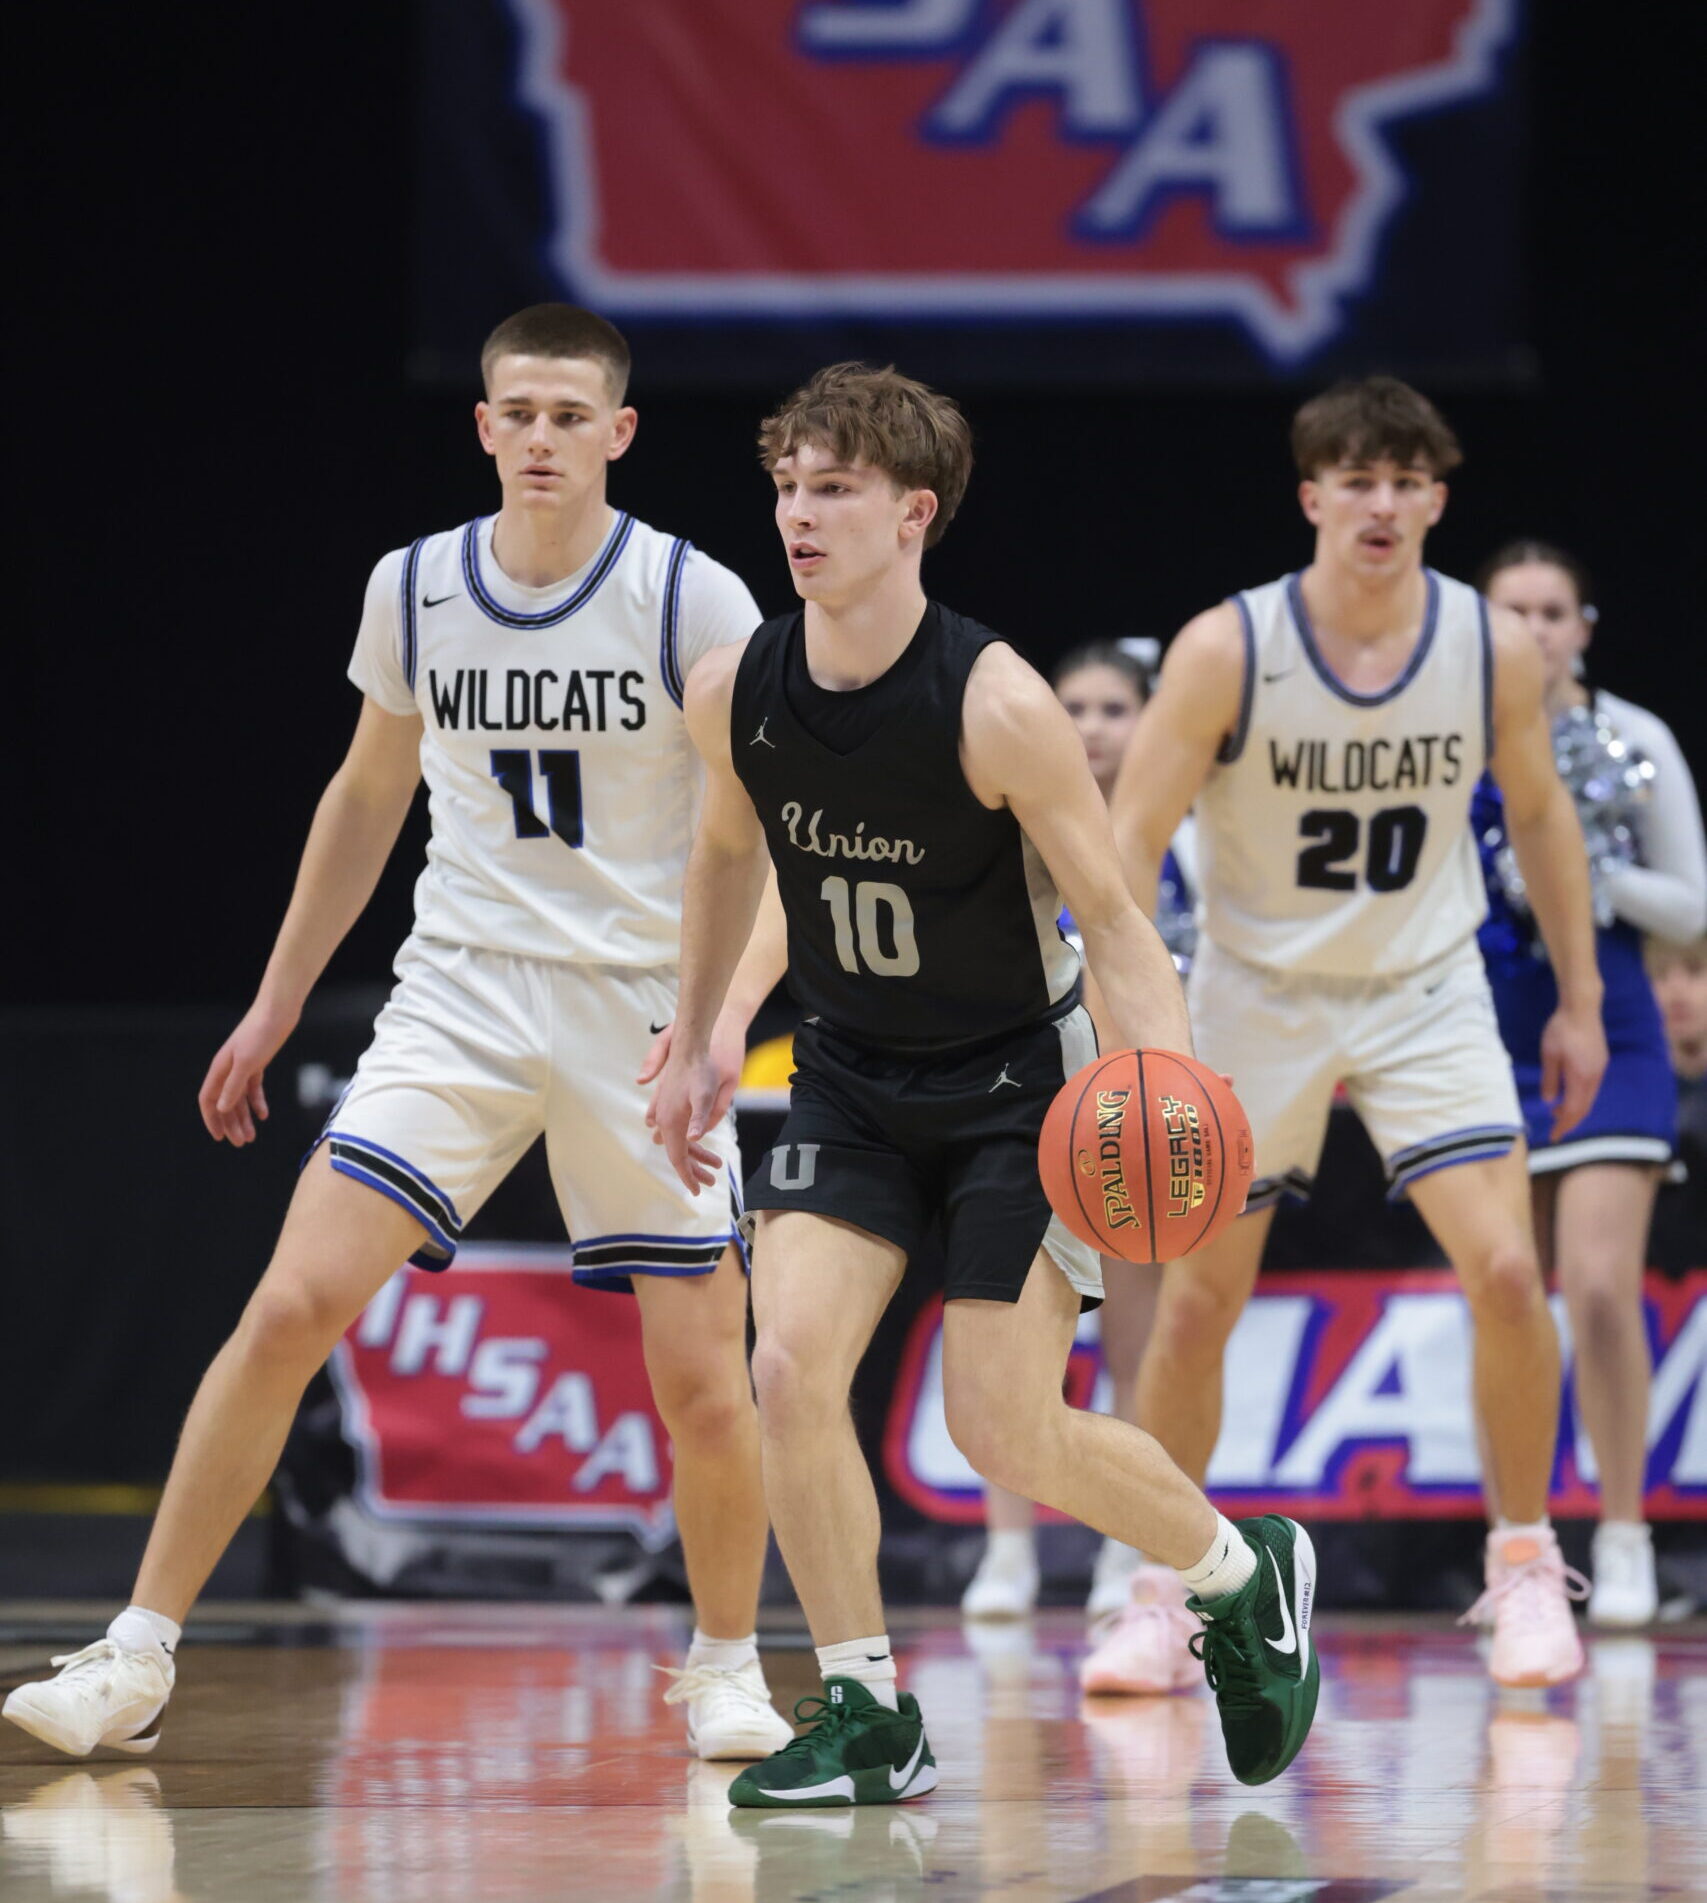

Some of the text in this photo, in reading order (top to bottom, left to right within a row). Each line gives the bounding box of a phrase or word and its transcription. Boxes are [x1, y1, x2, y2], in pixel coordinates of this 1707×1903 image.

[429, 669, 646, 731] WILDCATS
[490, 749, 583, 849] 11
[1268, 734, 1463, 792] WILDCATS
[781, 801, 925, 865] Union
[1295, 805, 1427, 892] 20
[820, 875, 920, 977] 10
[770, 1143, 821, 1190] U
[1097, 1089, 1140, 1230] SPALDING
[1159, 1096, 1189, 1218] LEGACY
[357, 1269, 659, 1493] IHSAA
